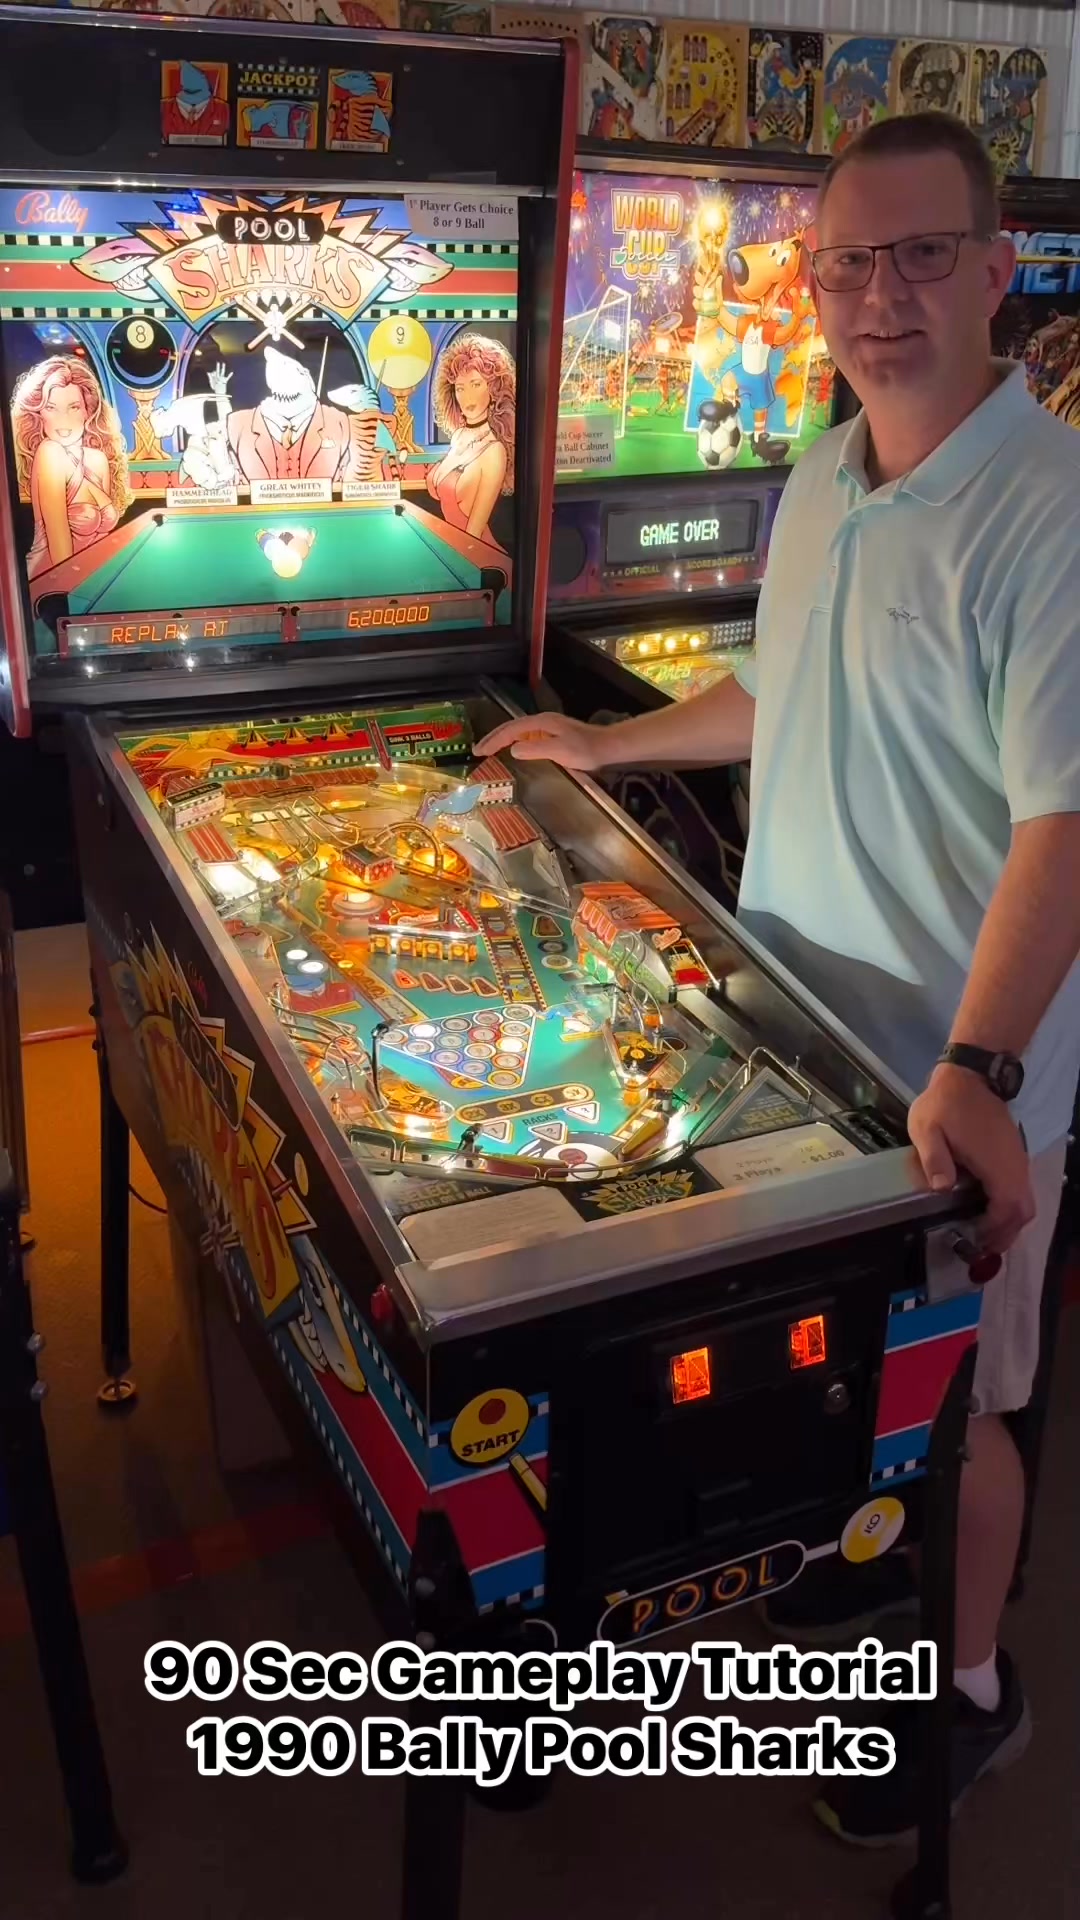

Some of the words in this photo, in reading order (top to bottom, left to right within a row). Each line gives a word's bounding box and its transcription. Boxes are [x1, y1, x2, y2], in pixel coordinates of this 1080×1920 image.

[240, 71, 319, 88] JACKPOT
[16, 191, 88, 232] Bally
[420, 200, 451, 213] Player
[453, 202, 476, 213] Gets
[479, 203, 514, 215] Choice
[615, 195, 680, 231] WORLD
[234, 217, 310, 242] POOL
[433, 217, 440, 228] 8
[442, 220, 452, 228] or
[455, 218, 462, 228] 9
[465, 218, 485, 229] Ball
[164, 244, 374, 310] SHARKS
[135, 325, 147, 343] 8
[396, 326, 405, 344] 9
[260, 483, 288, 491] GREAT
[640, 522, 680, 546] GAME
[683, 519, 720, 543] OVER
[111, 623, 190, 644] REPLAY
[203, 620, 229, 638] AT
[521, 1113, 559, 1127] RACKS
[461, 1429, 521, 1458] START
[633, 1554, 778, 1635] POOL
